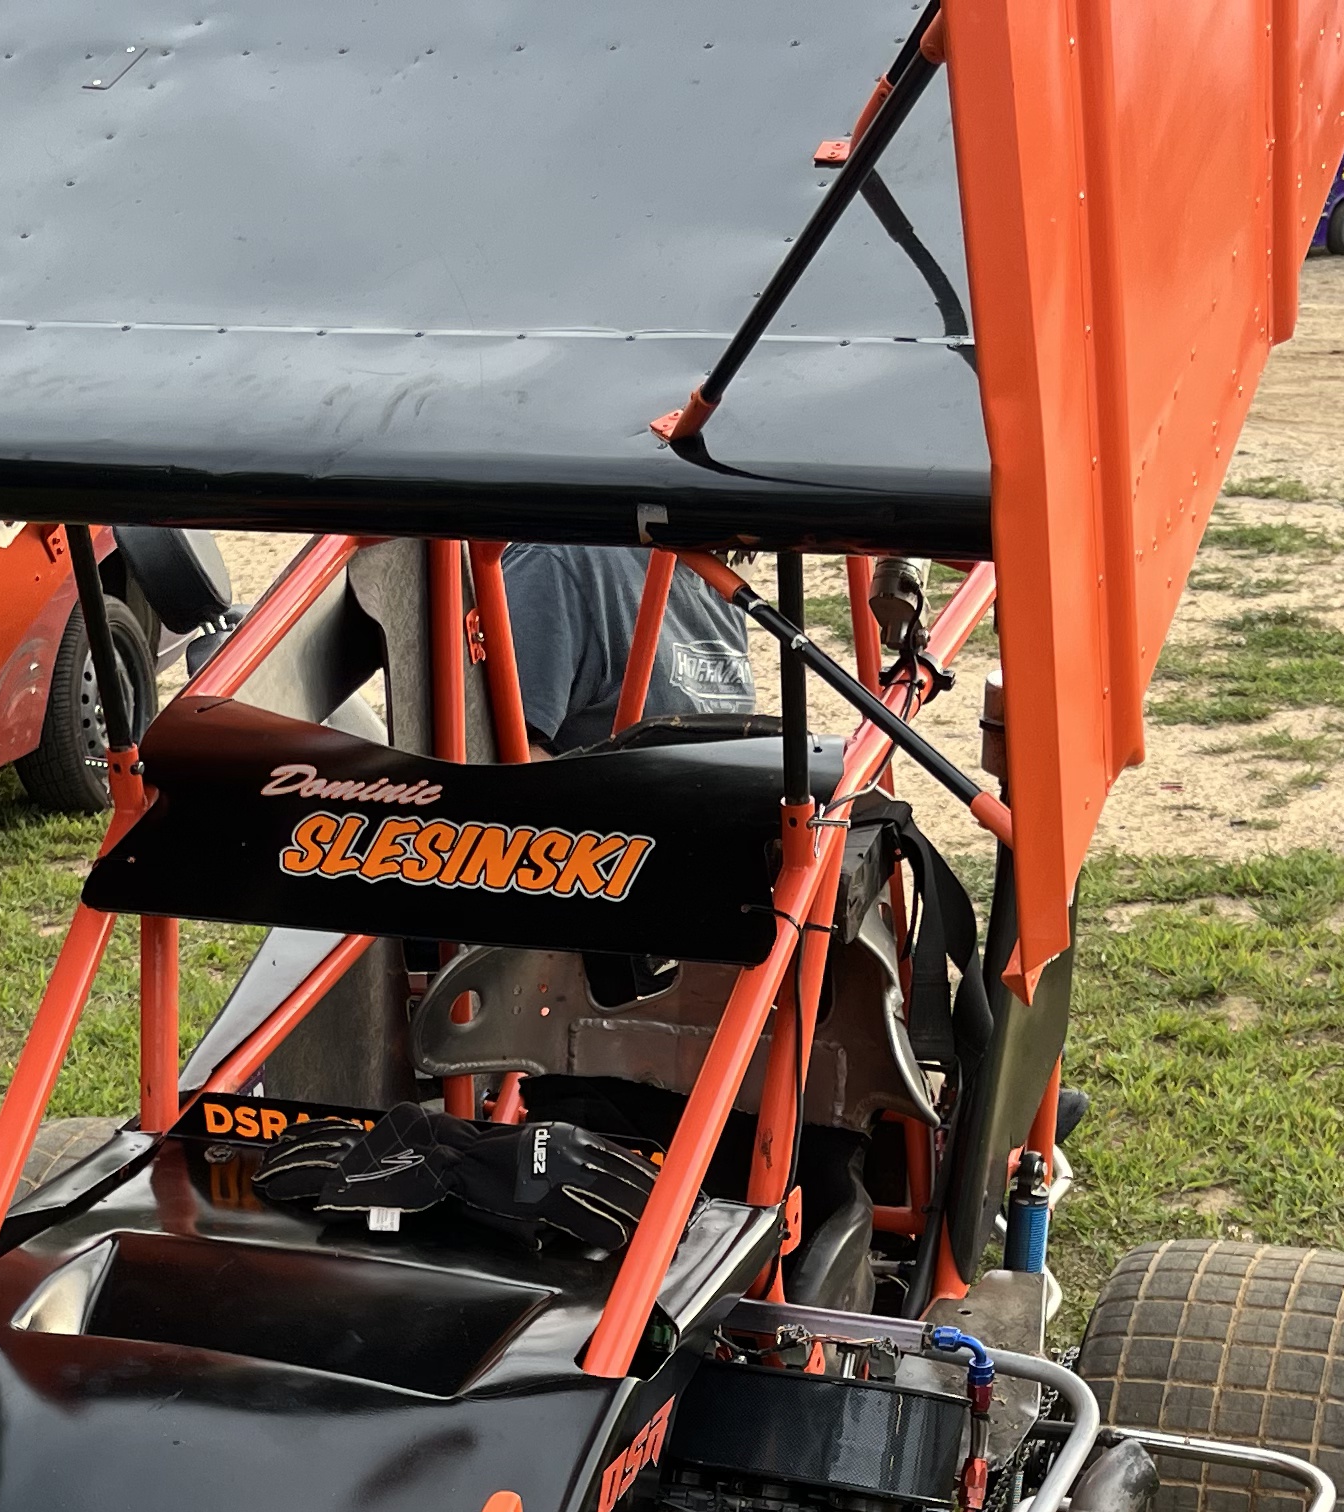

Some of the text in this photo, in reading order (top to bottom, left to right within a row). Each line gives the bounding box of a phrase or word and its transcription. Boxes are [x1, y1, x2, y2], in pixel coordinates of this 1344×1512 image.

[261, 763, 444, 806] Dominic
[279, 810, 656, 903] SLESINSKI
[533, 1128, 551, 1175] zamp
